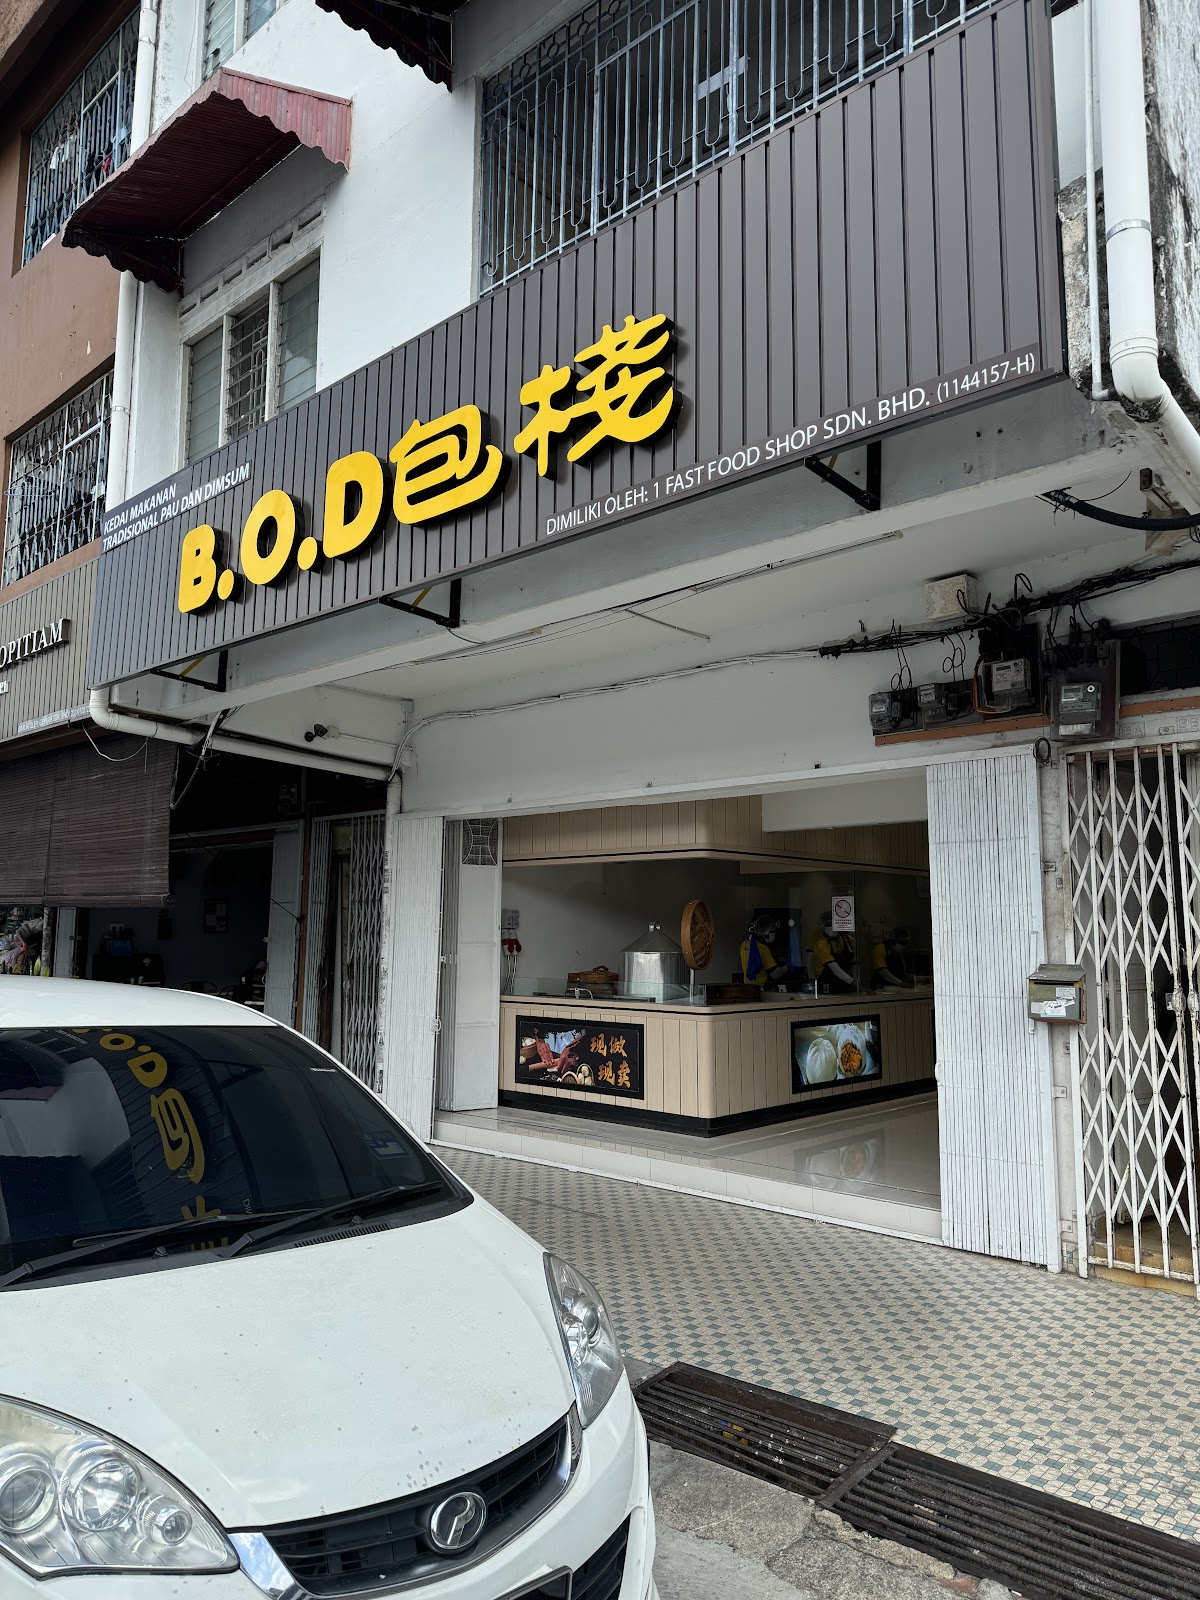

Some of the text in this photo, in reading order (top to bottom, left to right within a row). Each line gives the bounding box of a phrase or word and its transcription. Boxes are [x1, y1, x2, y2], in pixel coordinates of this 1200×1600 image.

[546, 352, 1035, 535] DIMILIKI OLEH: 1 FAST FOOD SHOP SDN. BHD. (1144157-H)
[102, 462, 250, 552] TRADISIONAL PAU DAN DIMSUM
[104, 482, 177, 536] KEDAI MAKANAN
